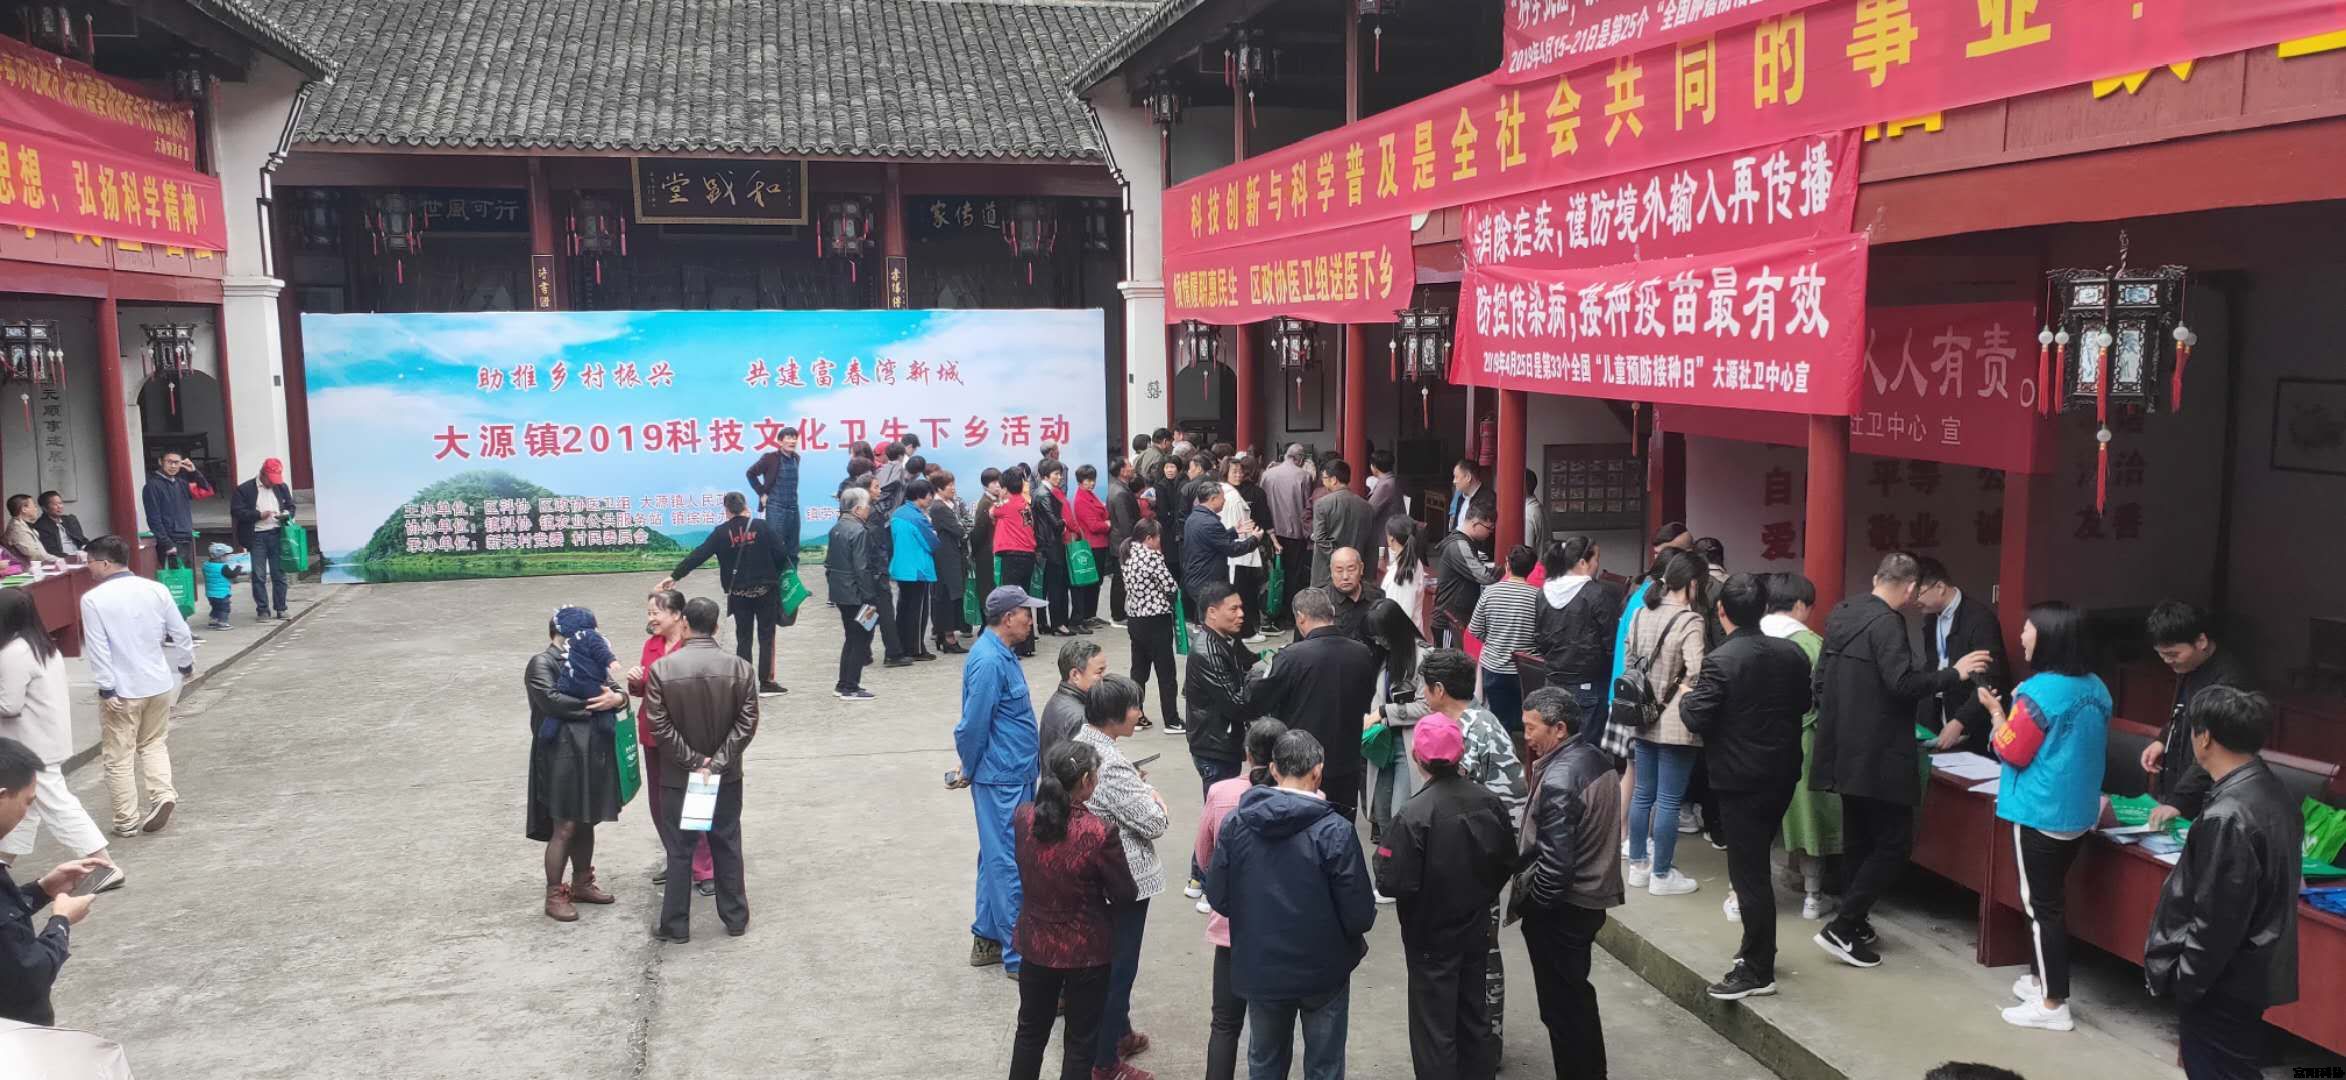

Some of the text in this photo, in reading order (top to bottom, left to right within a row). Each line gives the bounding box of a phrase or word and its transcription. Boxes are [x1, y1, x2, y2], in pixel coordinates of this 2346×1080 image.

[1191, 0, 2143, 240] 科技创新与科学普及是全社会共同的事业
[1250, 245, 1393, 305] 区政协医卫组送医下乡
[477, 357, 965, 391] 助推乡村振兴 共建富春湾新城
[1712, 361, 1811, 394] 大源社卫中心宣
[433, 414, 1071, 460] 大源镇2019科技文化卫生下乡活动
[1940, 416, 1961, 445] 宣
[571, 528, 649, 546] 村民委员会
